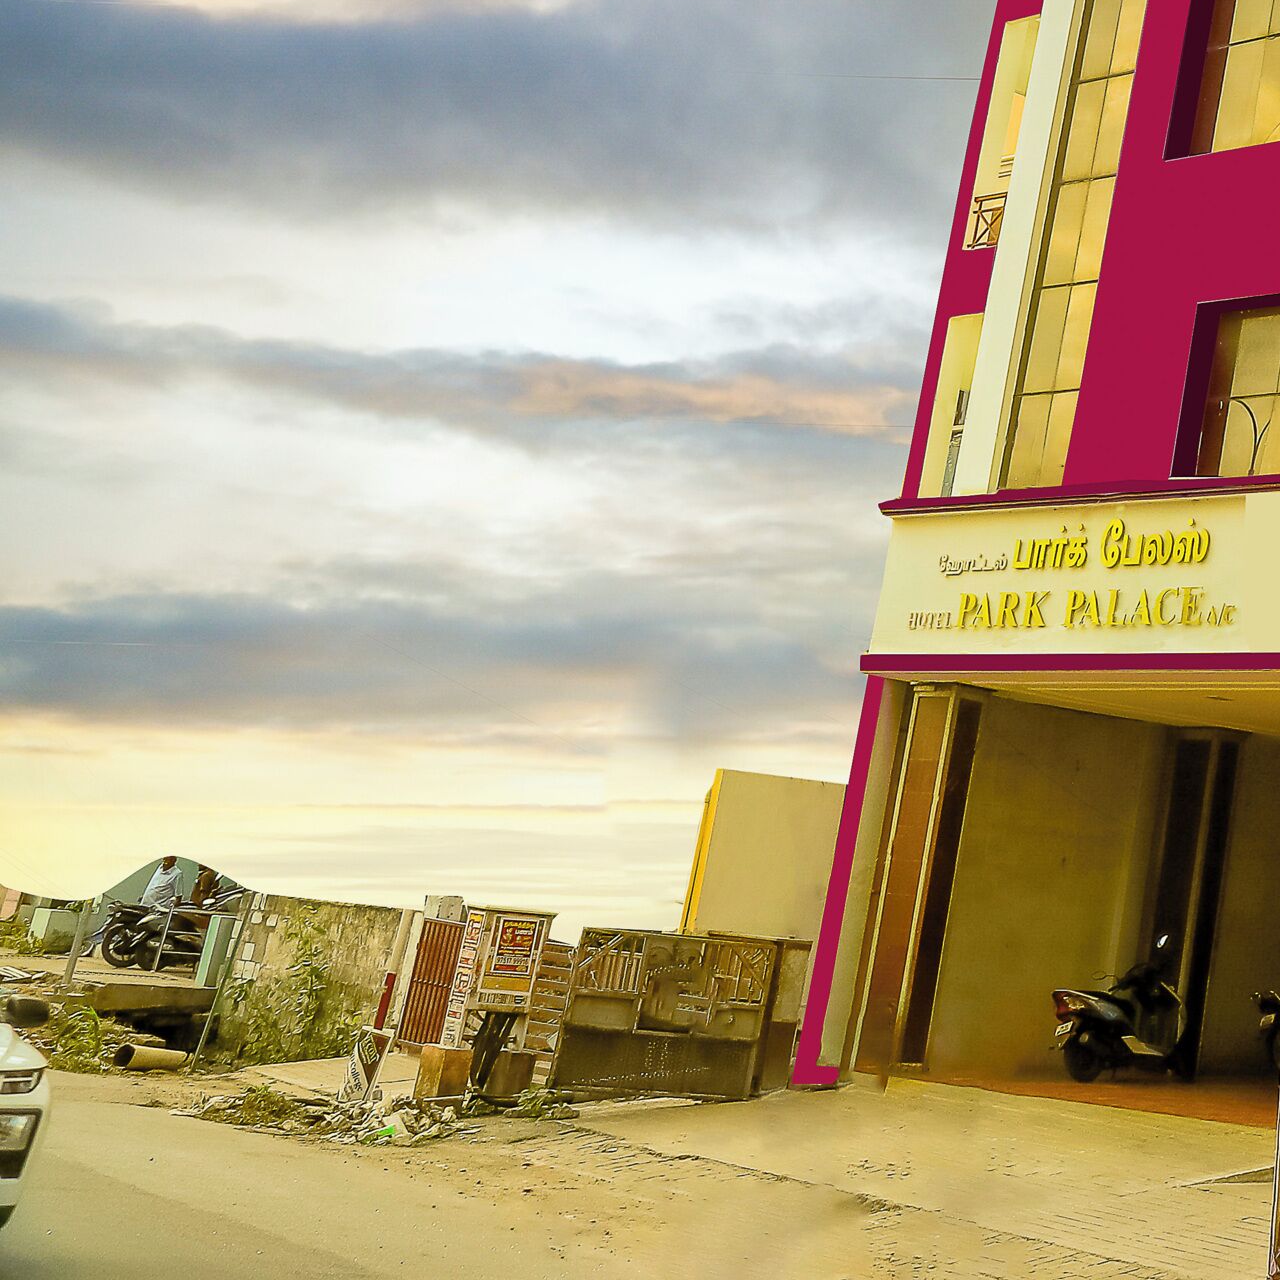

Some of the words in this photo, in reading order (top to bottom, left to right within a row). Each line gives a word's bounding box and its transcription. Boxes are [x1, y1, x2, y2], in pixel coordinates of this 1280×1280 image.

[1013, 524, 1088, 570] பார்க்
[1101, 518, 1211, 568] பேலஸ்
[908, 611, 954, 631] HOTEL
[955, 590, 1051, 629] PARK
[1062, 586, 1206, 629] PALACE
